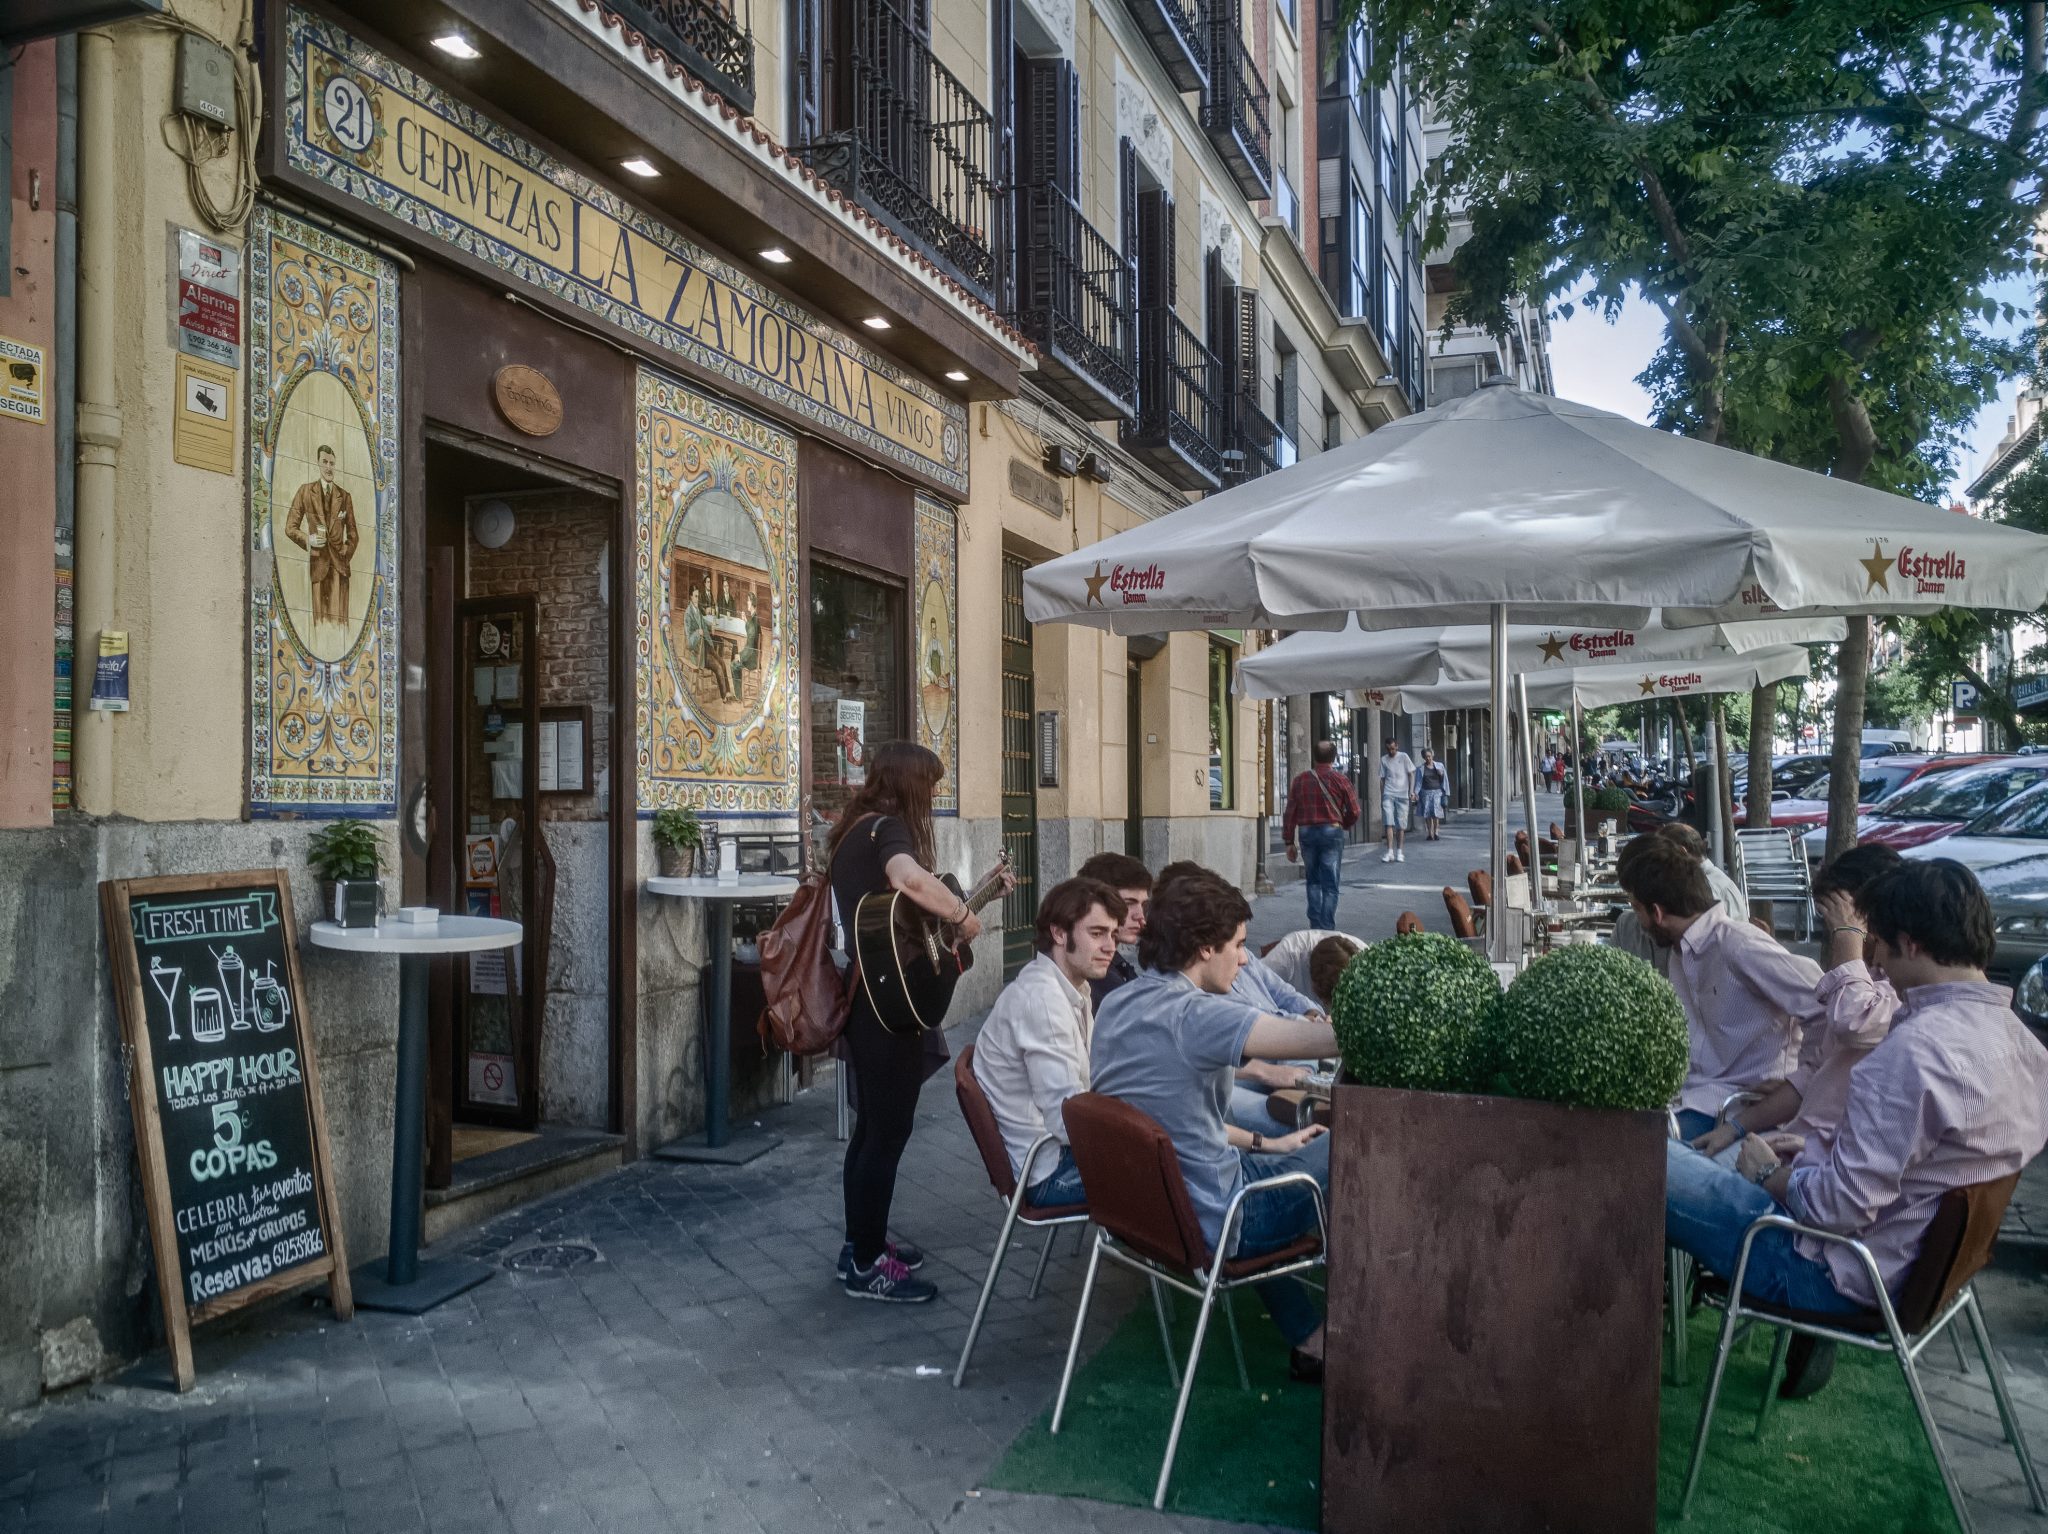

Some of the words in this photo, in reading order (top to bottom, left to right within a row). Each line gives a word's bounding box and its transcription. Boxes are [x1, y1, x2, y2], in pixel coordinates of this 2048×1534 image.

[201, 102, 225, 118] 4094
[333, 85, 366, 146] 21
[190, 261, 232, 279] Direct
[396, 116, 562, 252] CERVEZAS
[569, 196, 643, 311] LA
[663, 254, 877, 430] ZAMORANA
[885, 391, 933, 449] VINOS
[185, 284, 236, 314] Alarma
[0, 341, 41, 360] ECTADA
[192, 335, 206, 346] 902
[206, 339, 220, 351] 366
[220, 344, 233, 355] 366
[0, 397, 41, 418] SEGUR
[1897, 545, 1966, 580] Estrella
[1110, 563, 1166, 592] Estrella
[1917, 578, 1946, 594] Damm
[1122, 590, 1148, 605] Damm
[1569, 629, 1635, 651] Estrella
[1588, 648, 1617, 659] Damm
[1659, 672, 1702, 687] Estrella
[840, 711, 863, 720] SECRETO
[149, 909, 207, 939] FRESH
[209, 905, 254, 932] TIME
[163, 1057, 234, 1099] HAPPY
[239, 1048, 301, 1086] HOUR
[168, 1095, 200, 1111] TODOS
[202, 1091, 219, 1104] LOS
[190, 1139, 279, 1183] COPAS
[176, 1192, 249, 1234] CELEBRA
[250, 1183, 271, 1213] tus
[272, 1166, 313, 1202] eventos
[190, 1230, 248, 1266] MENÚS
[258, 1209, 307, 1242] GRUPOS
[214, 1220, 235, 1239] con
[189, 1254, 273, 1302] Reservas
[272, 1227, 324, 1268] 692539866
